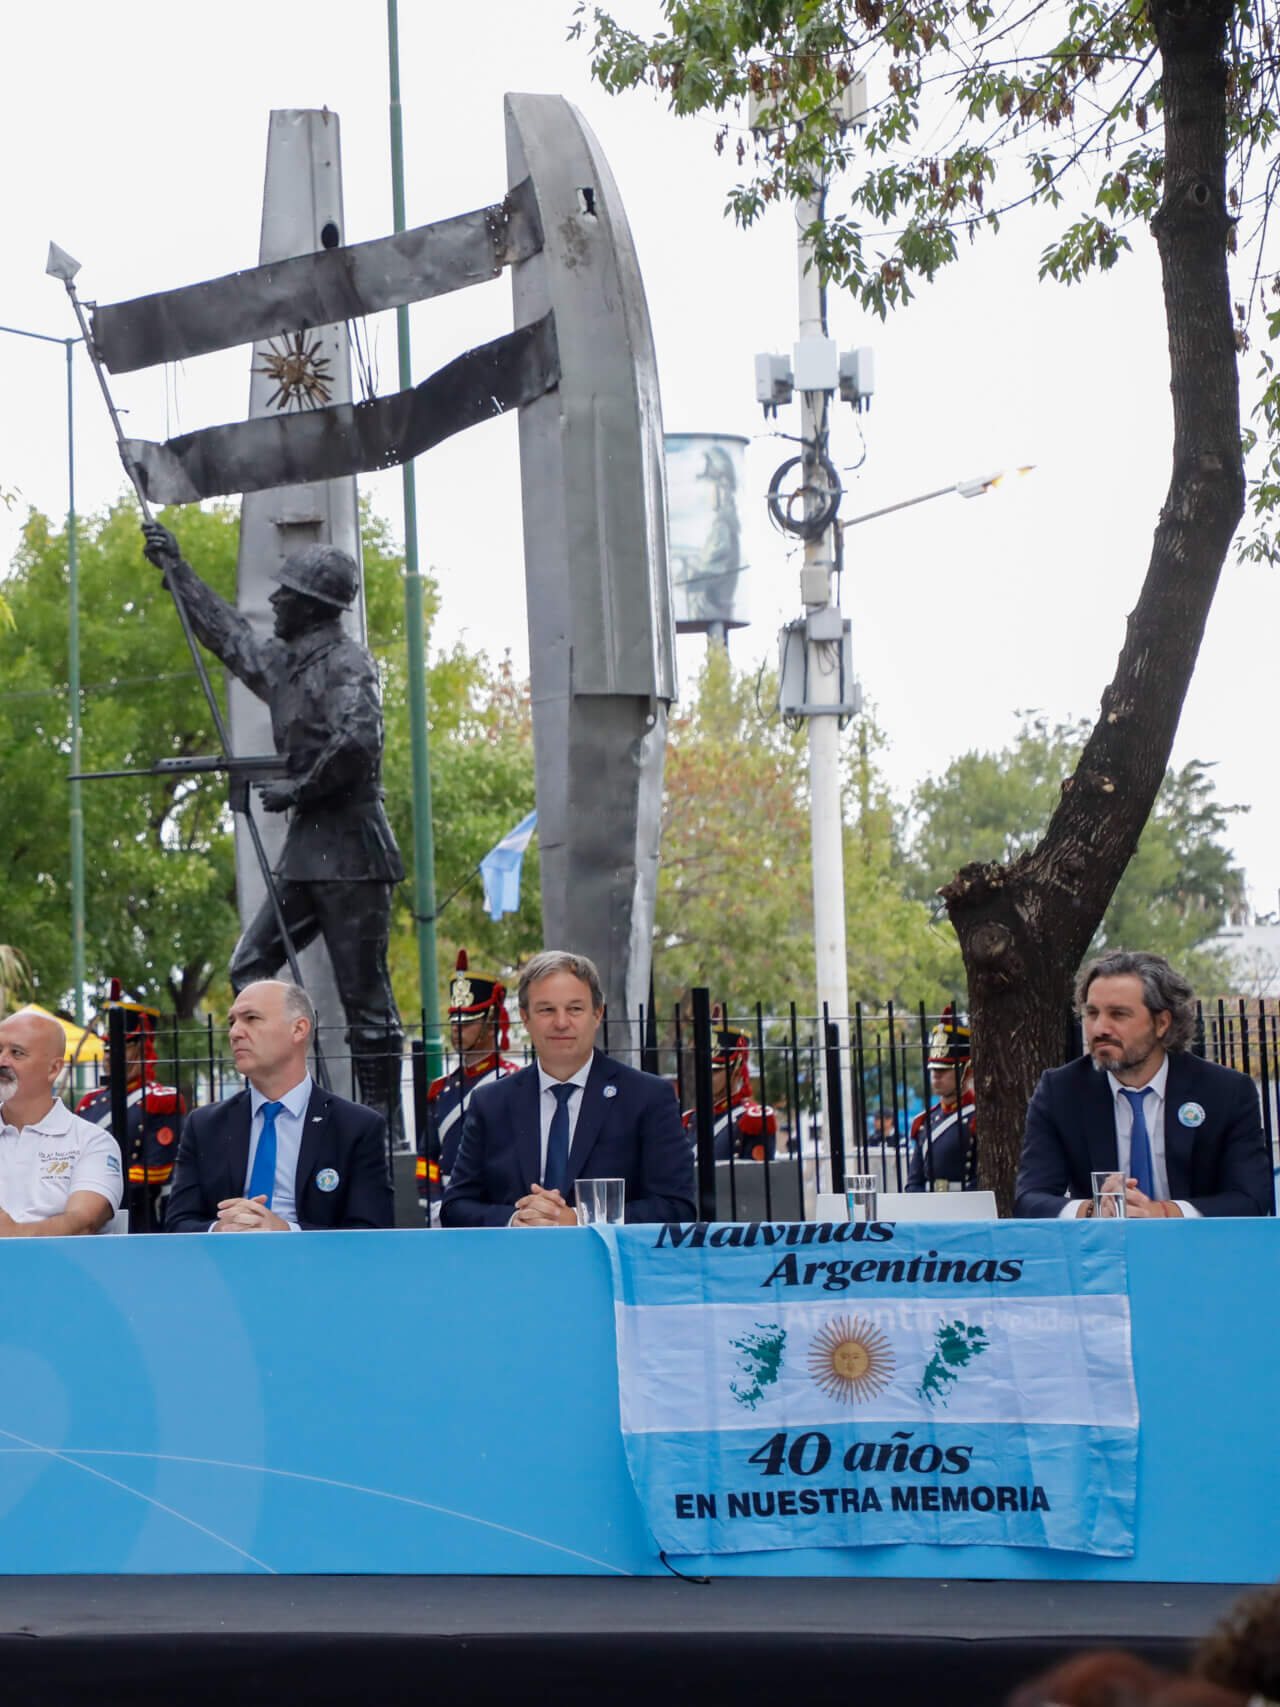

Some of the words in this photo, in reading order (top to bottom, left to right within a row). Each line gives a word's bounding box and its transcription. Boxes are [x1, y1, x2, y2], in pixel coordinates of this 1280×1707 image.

[760, 1250, 1024, 1291] Argentinas
[748, 1431, 832, 1476] 40
[843, 1431, 973, 1475] años
[675, 1494, 718, 1519] EN
[728, 1487, 883, 1518] NUESTRA
[891, 1486, 1051, 1512] MEMORIA
